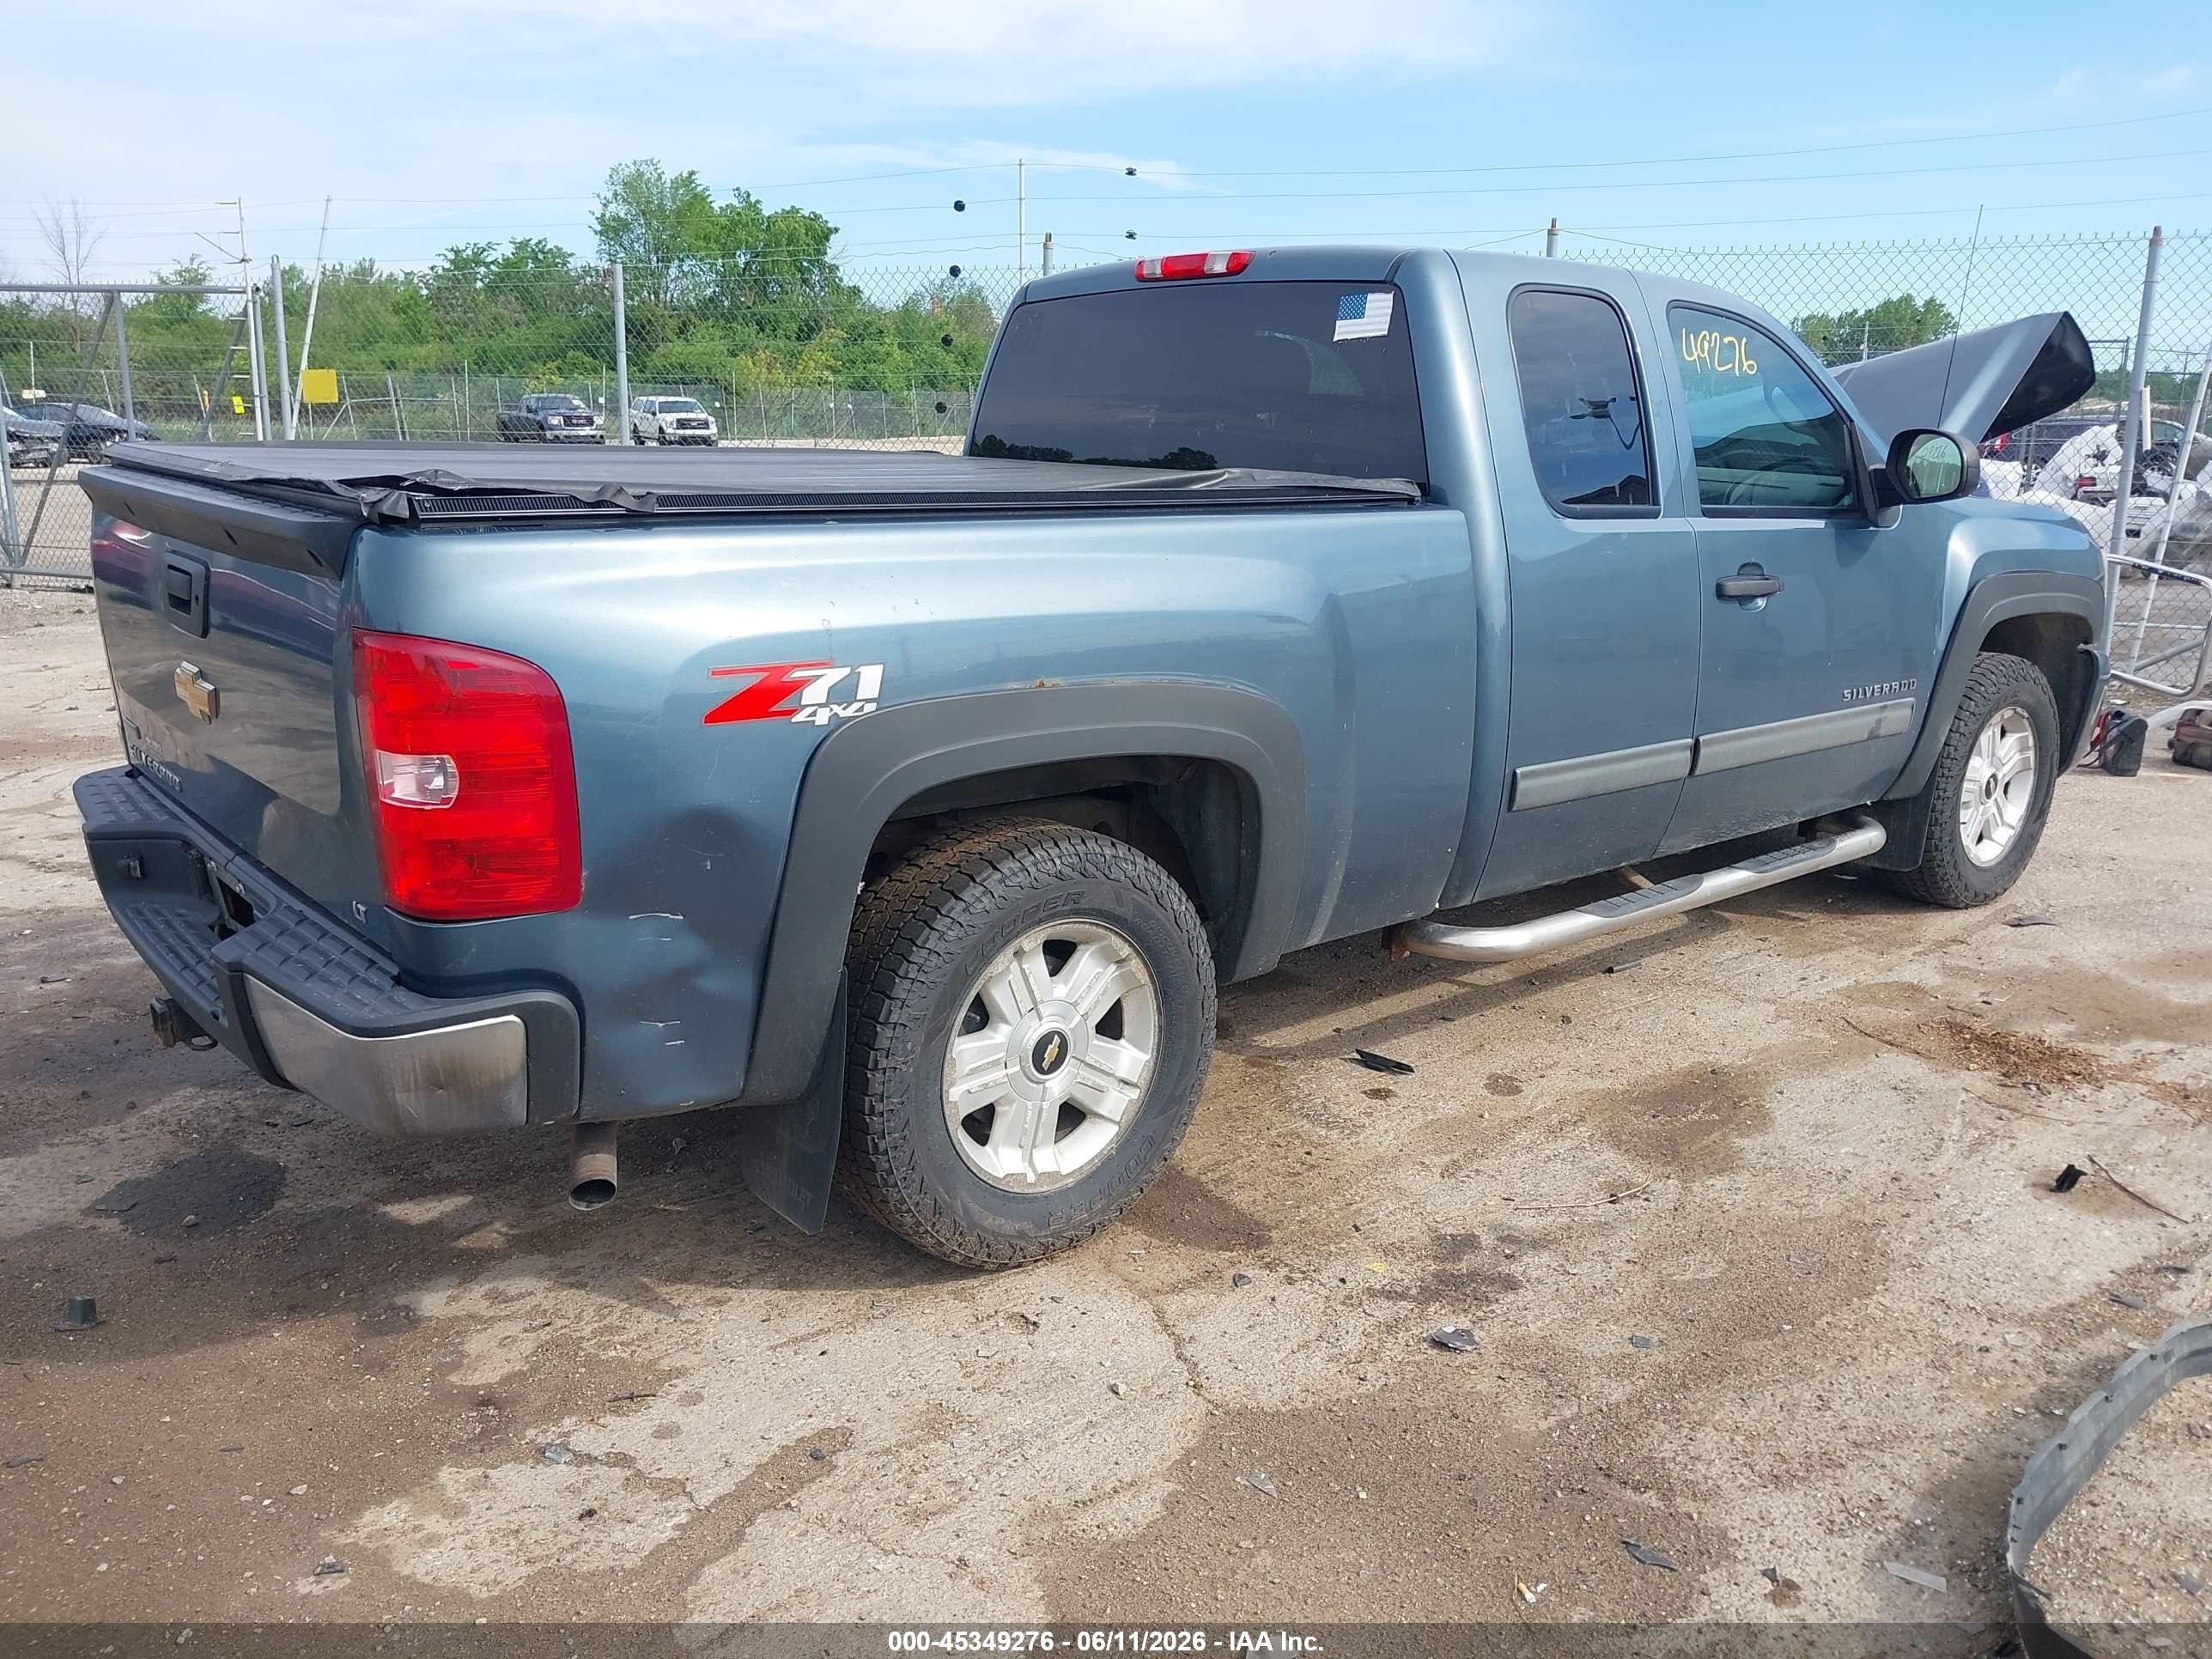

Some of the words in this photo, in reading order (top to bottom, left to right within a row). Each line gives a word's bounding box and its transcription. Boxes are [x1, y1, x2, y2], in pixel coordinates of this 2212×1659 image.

[1683, 328, 1758, 377] 49276
[702, 659, 884, 726] Z71
[1842, 678, 1917, 702] SILVERADO
[352, 900, 367, 924] LT
